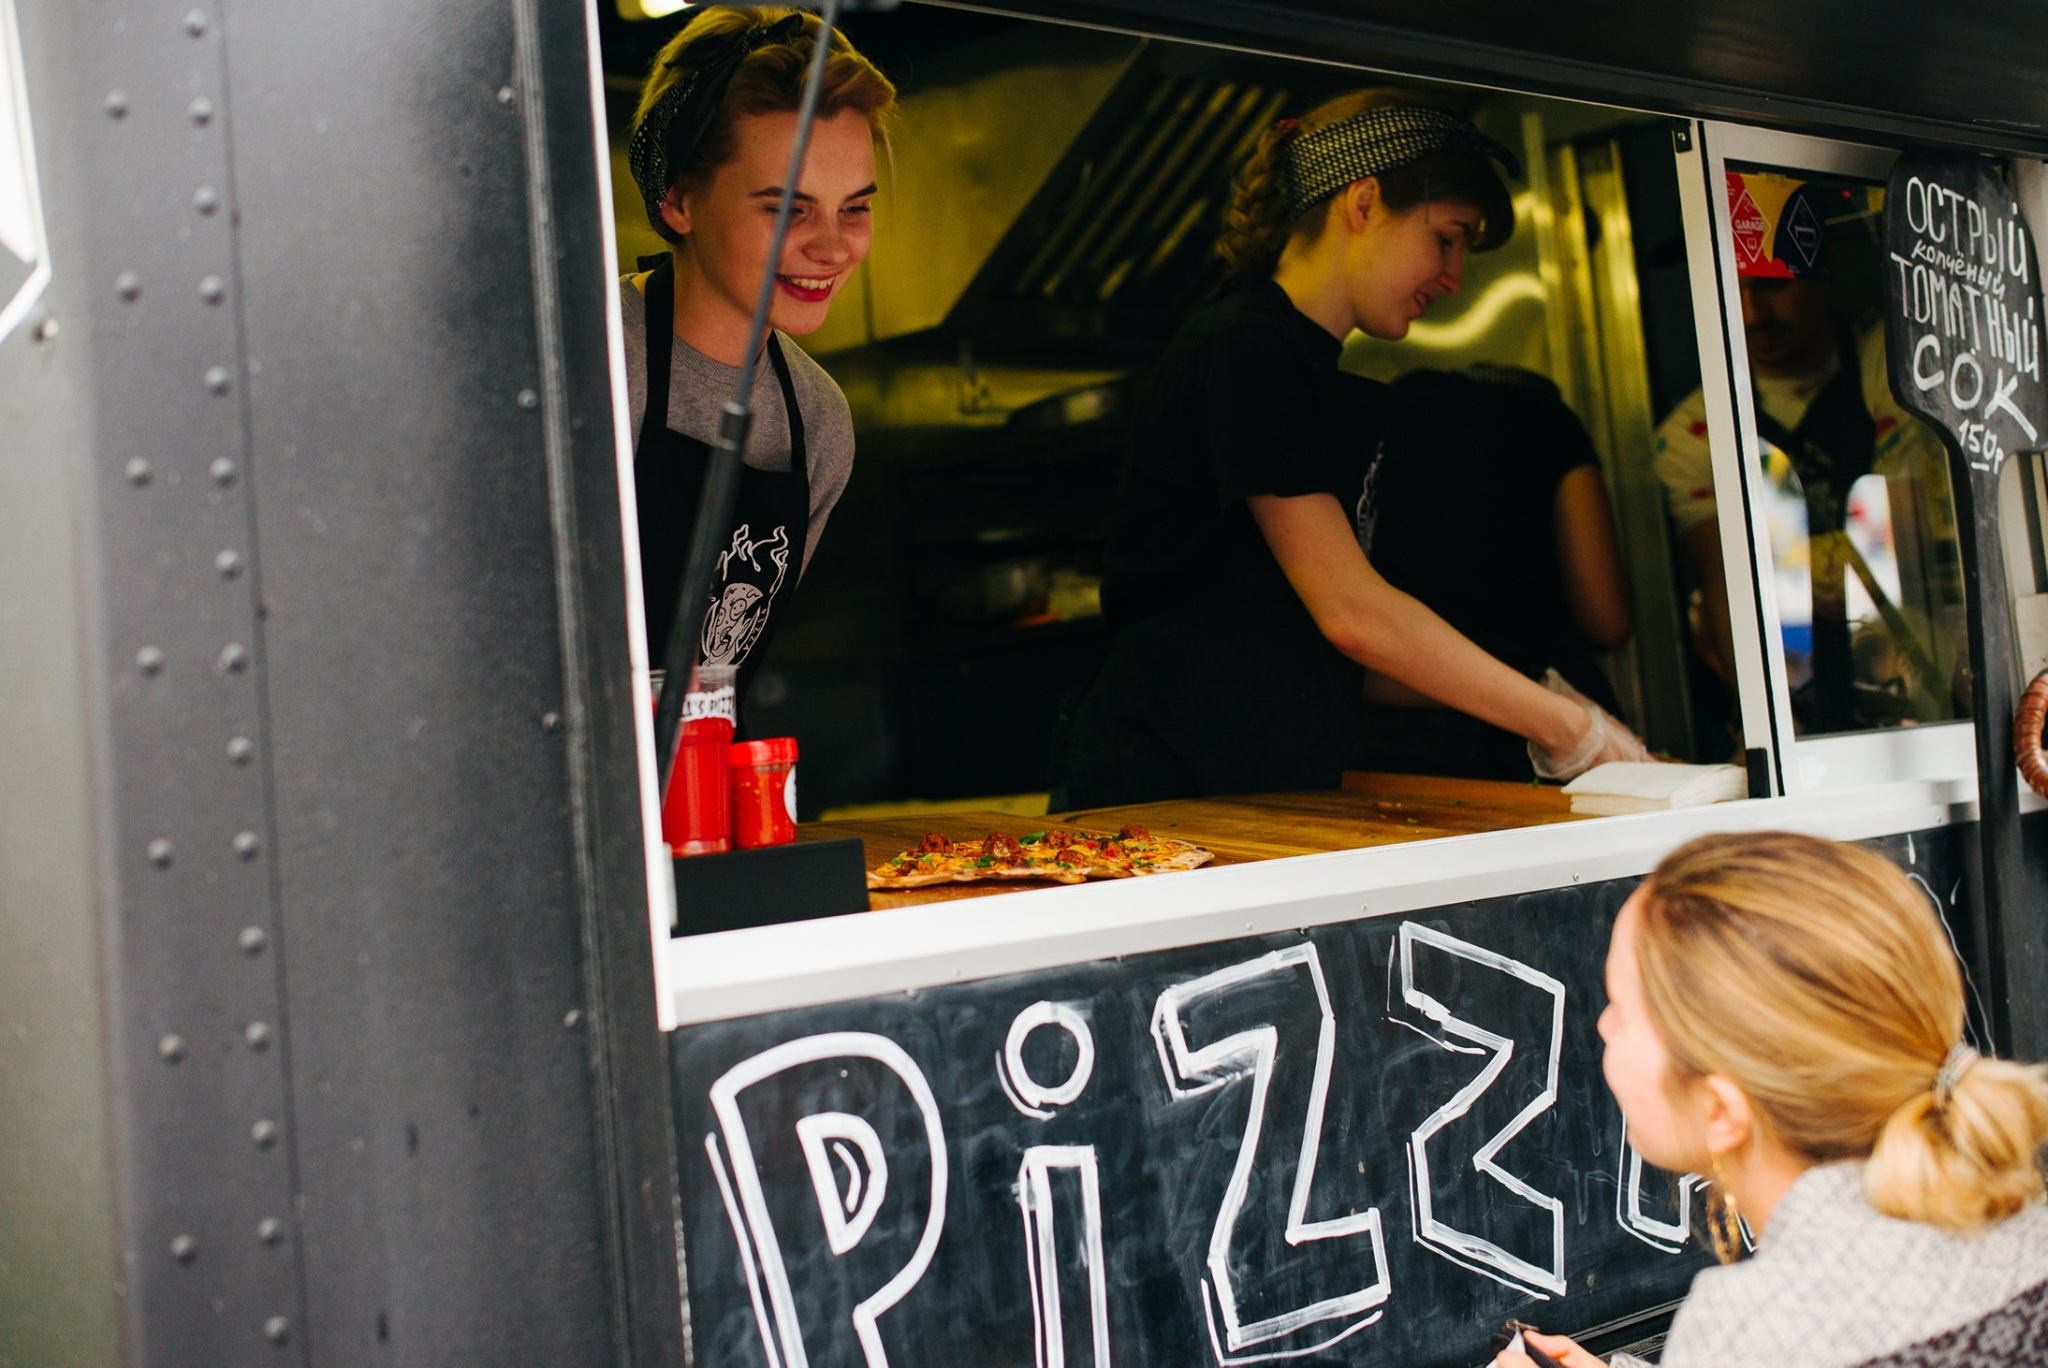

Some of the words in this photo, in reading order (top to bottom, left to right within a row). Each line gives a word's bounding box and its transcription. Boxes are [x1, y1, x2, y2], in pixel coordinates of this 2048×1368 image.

[1906, 176, 2028, 284] ОСТРЫЙ
[1890, 252, 2040, 383] ТОМАТНЫЙ
[1913, 333, 2039, 446] СОК
